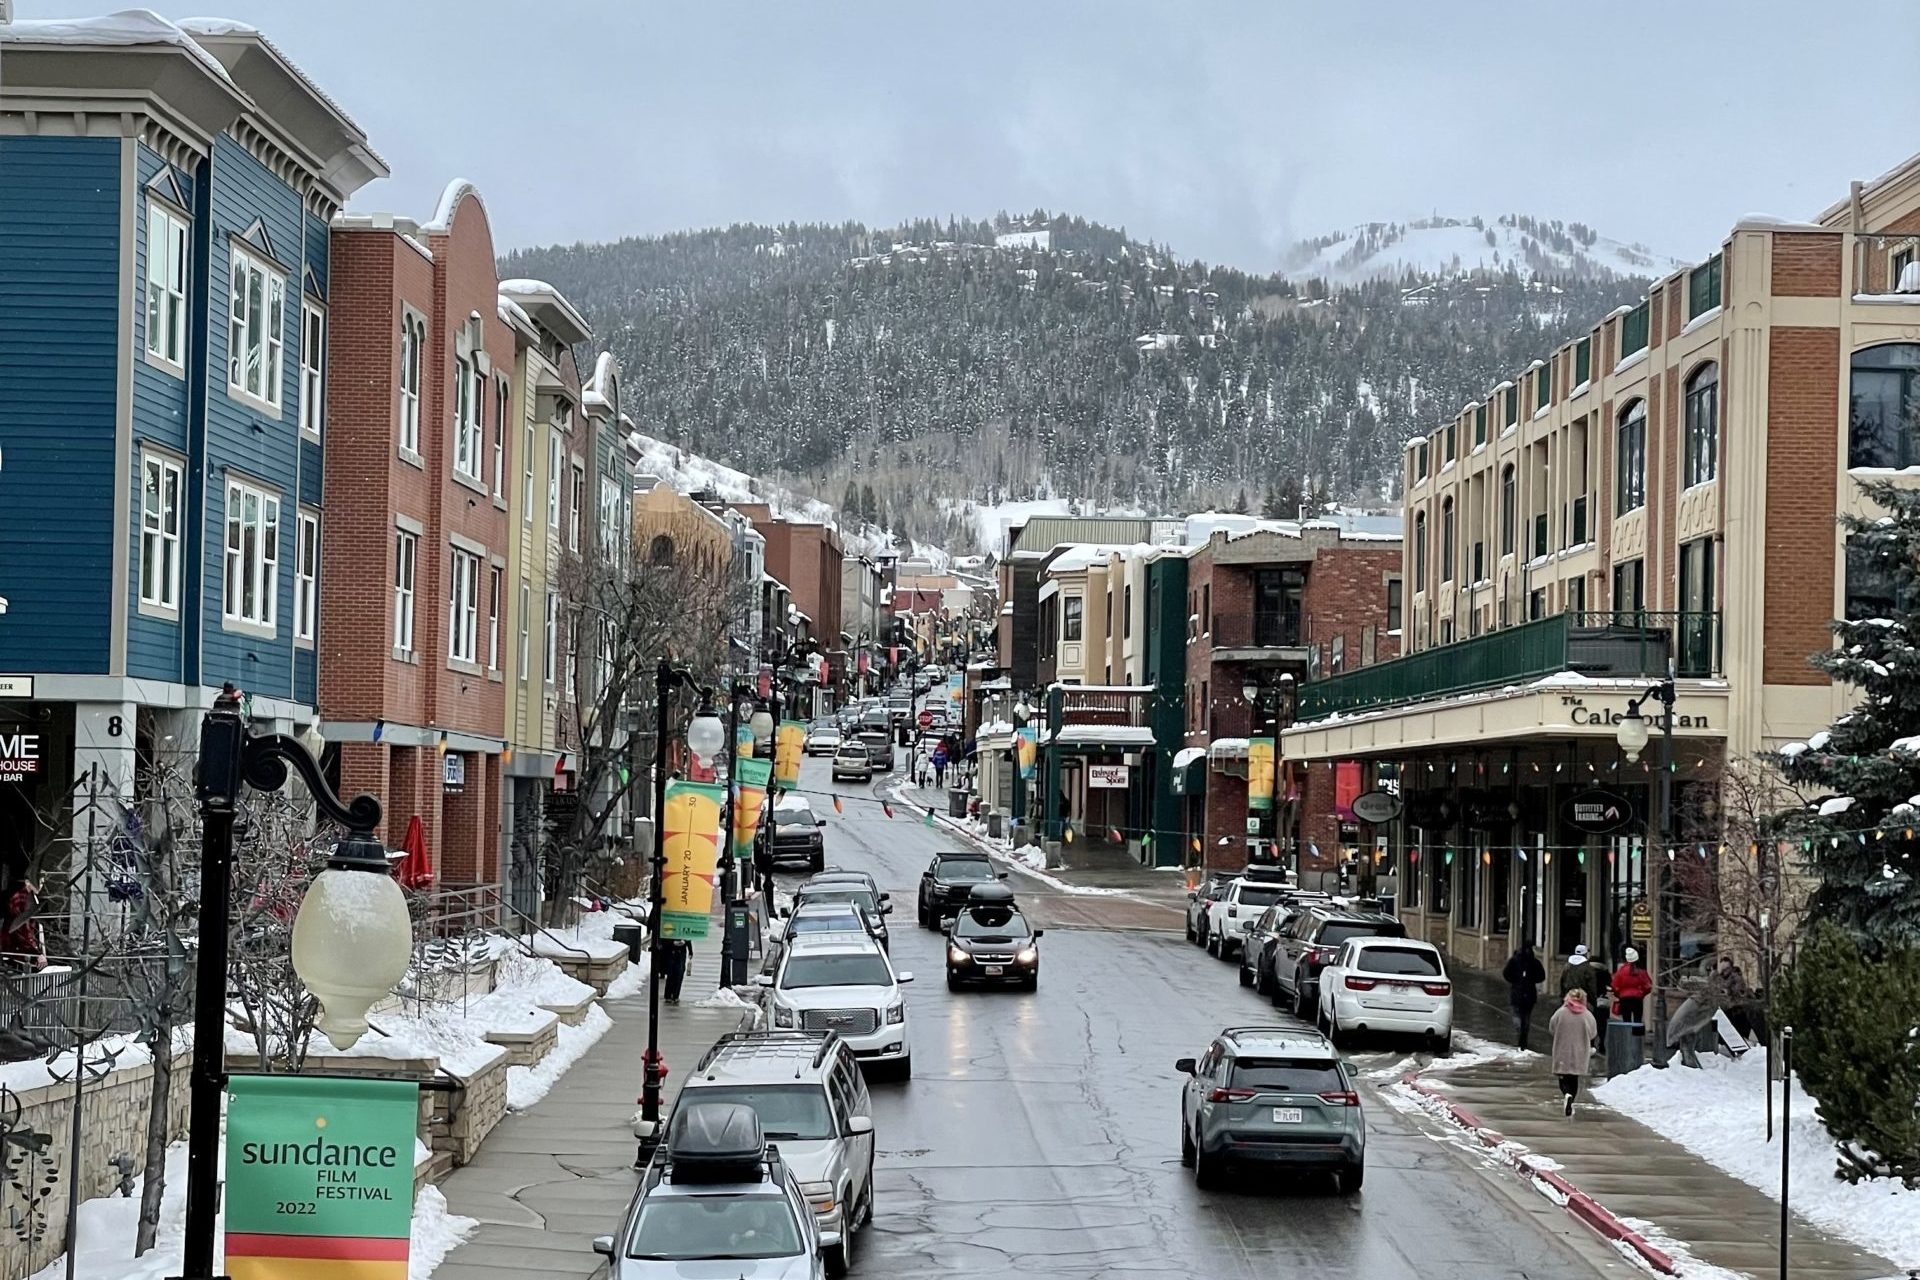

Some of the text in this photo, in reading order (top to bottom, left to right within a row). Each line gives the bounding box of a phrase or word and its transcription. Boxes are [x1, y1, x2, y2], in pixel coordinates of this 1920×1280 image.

[1561, 696, 1582, 705] The
[107, 716, 122, 737] 8
[3, 773, 23, 782] BAR
[680, 796, 697, 906] JANUARY 20 30
[242, 1136, 396, 1167] sundance
[317, 1169, 357, 1183] FILM
[316, 1186, 393, 1200] FESTIVAL
[276, 1201, 317, 1215] 2022
